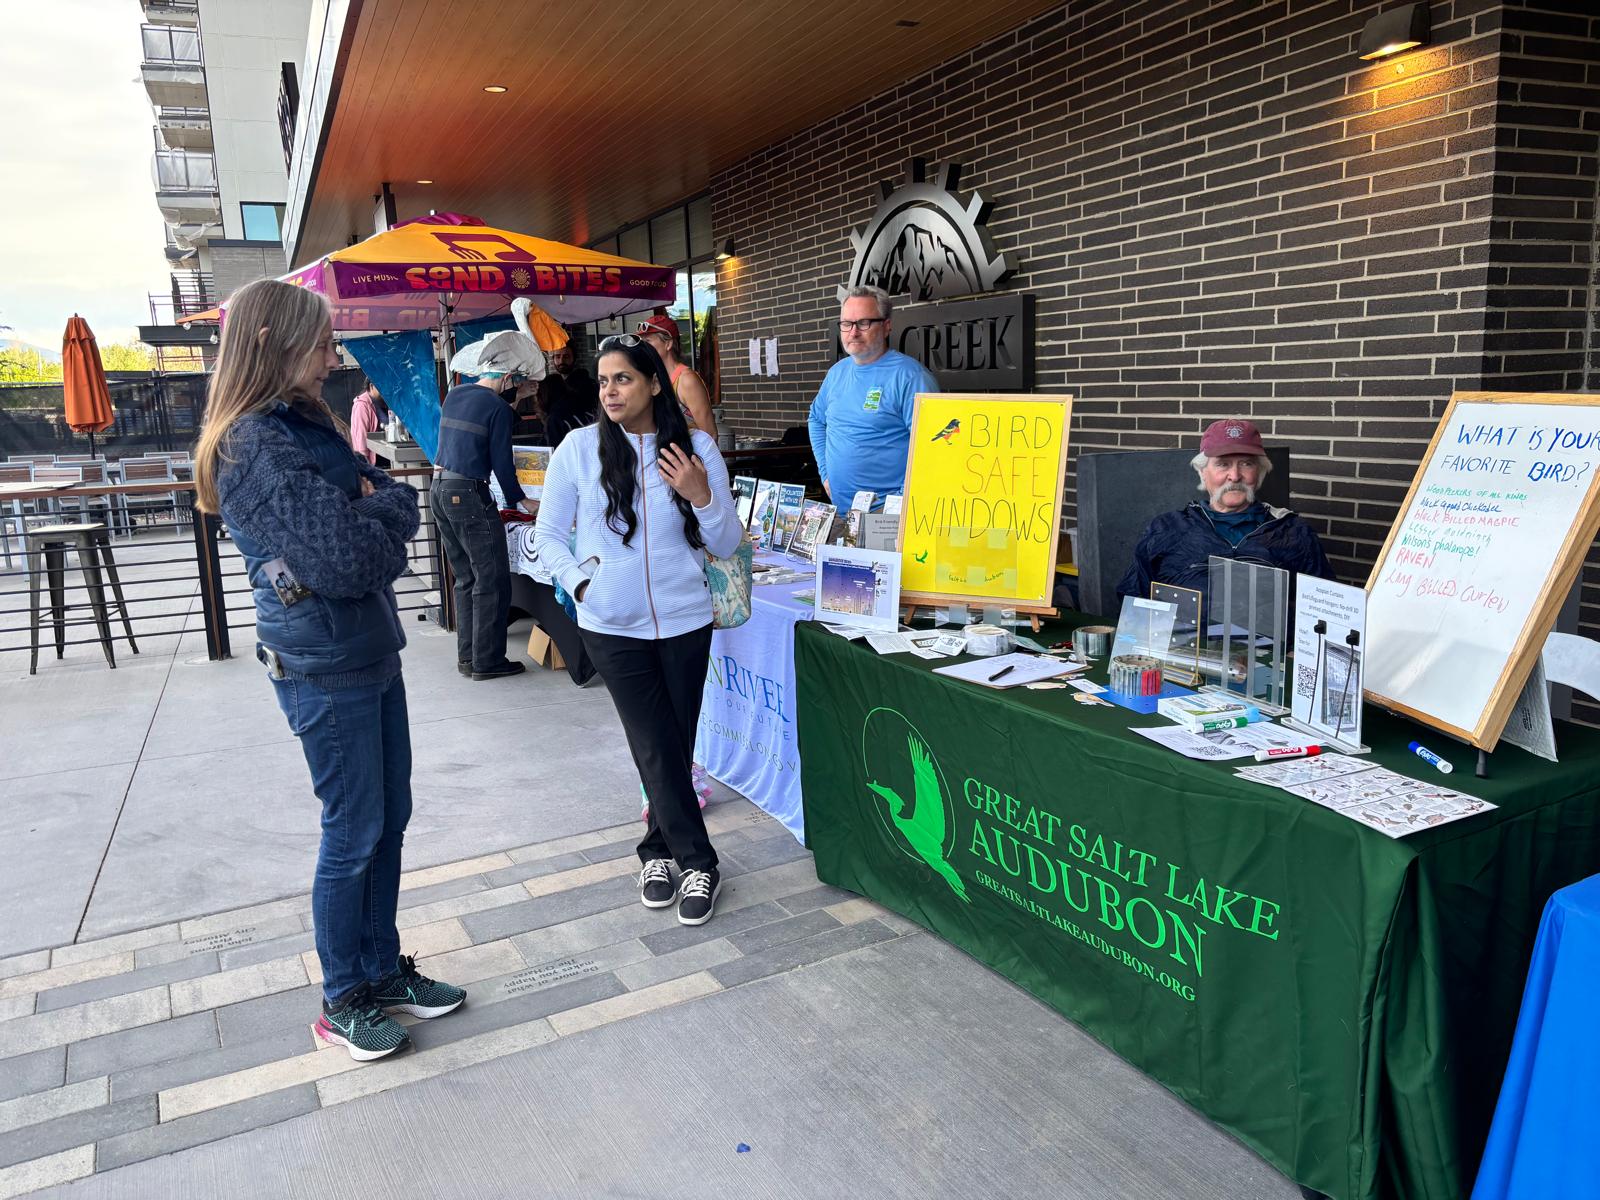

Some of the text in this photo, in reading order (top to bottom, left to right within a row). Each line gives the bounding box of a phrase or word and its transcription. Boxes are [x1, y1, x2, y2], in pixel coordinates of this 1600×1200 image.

[353, 275, 371, 284] LIVE
[836, 315, 1016, 372] CREEK
[969, 413, 1053, 449] BIRD
[1457, 424, 1523, 446] WHAT
[962, 453, 1047, 498] SAFE
[1441, 455, 1590, 487] FAVORITE BIRD?
[1489, 491, 1501, 499] ALL
[912, 495, 1053, 543] WINDOWS
[1477, 516, 1521, 527] MAGPIE
[1396, 546, 1436, 568] RAVEN
[708, 655, 791, 723] NRIVER
[963, 777, 1281, 942] GREAT SALT LAKE
[968, 818, 1207, 978] AUDUBON
[975, 869, 1197, 1002] GREATSALTLAKEAUDUBON.ORG
[503, 961, 595, 988] makes you happy
[553, 971, 580, 980] more
[558, 959, 577, 967] The
[583, 966, 599, 974] Do
[507, 984, 534, 994] what
